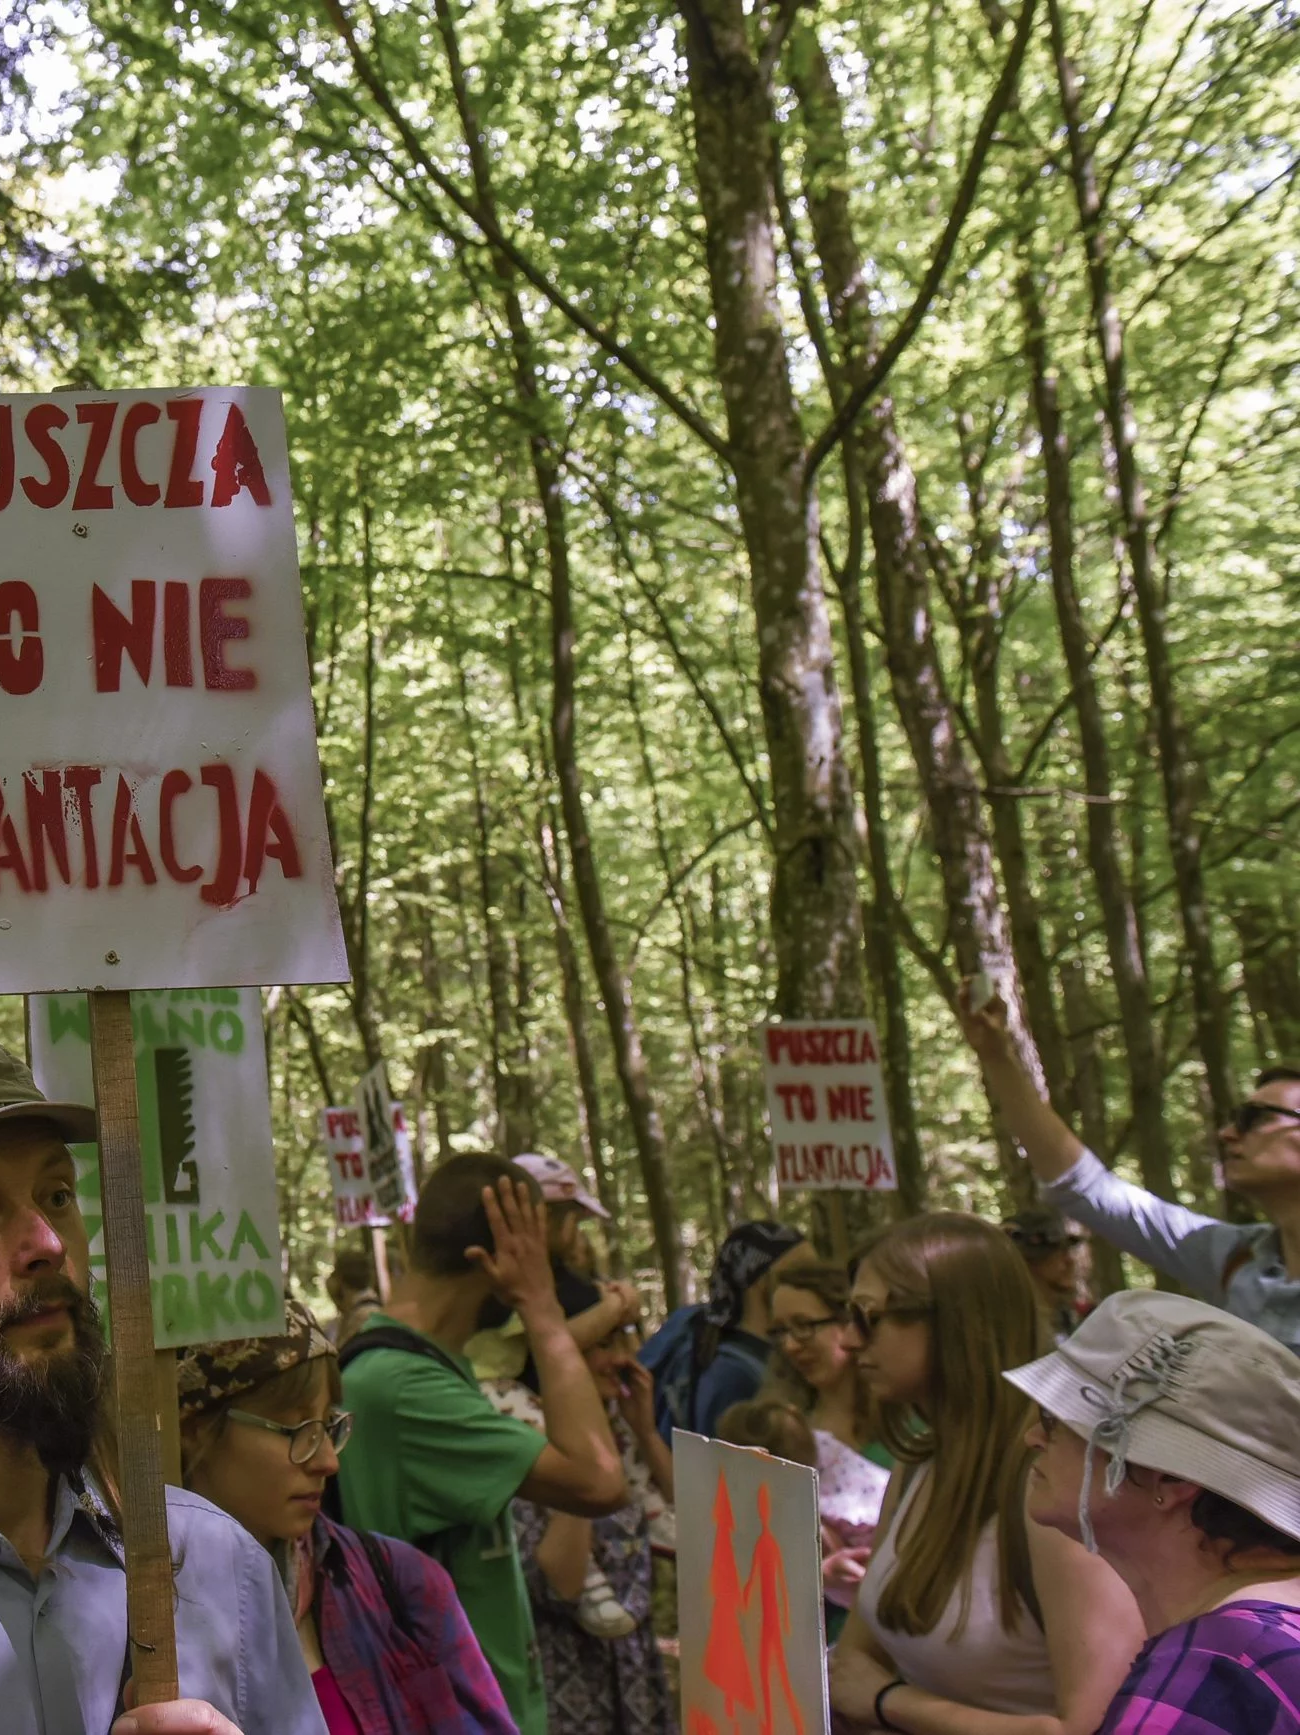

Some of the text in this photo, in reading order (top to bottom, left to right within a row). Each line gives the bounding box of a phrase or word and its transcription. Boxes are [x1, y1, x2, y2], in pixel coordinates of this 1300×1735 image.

[93, 577, 259, 692] NIE
[48, 994, 245, 1053] WLNO
[766, 1027, 877, 1066] PUSZCZA
[775, 1083, 875, 1123] TO NIE
[335, 1152, 364, 1180] TO
[777, 1143, 892, 1188] PLANTACJA
